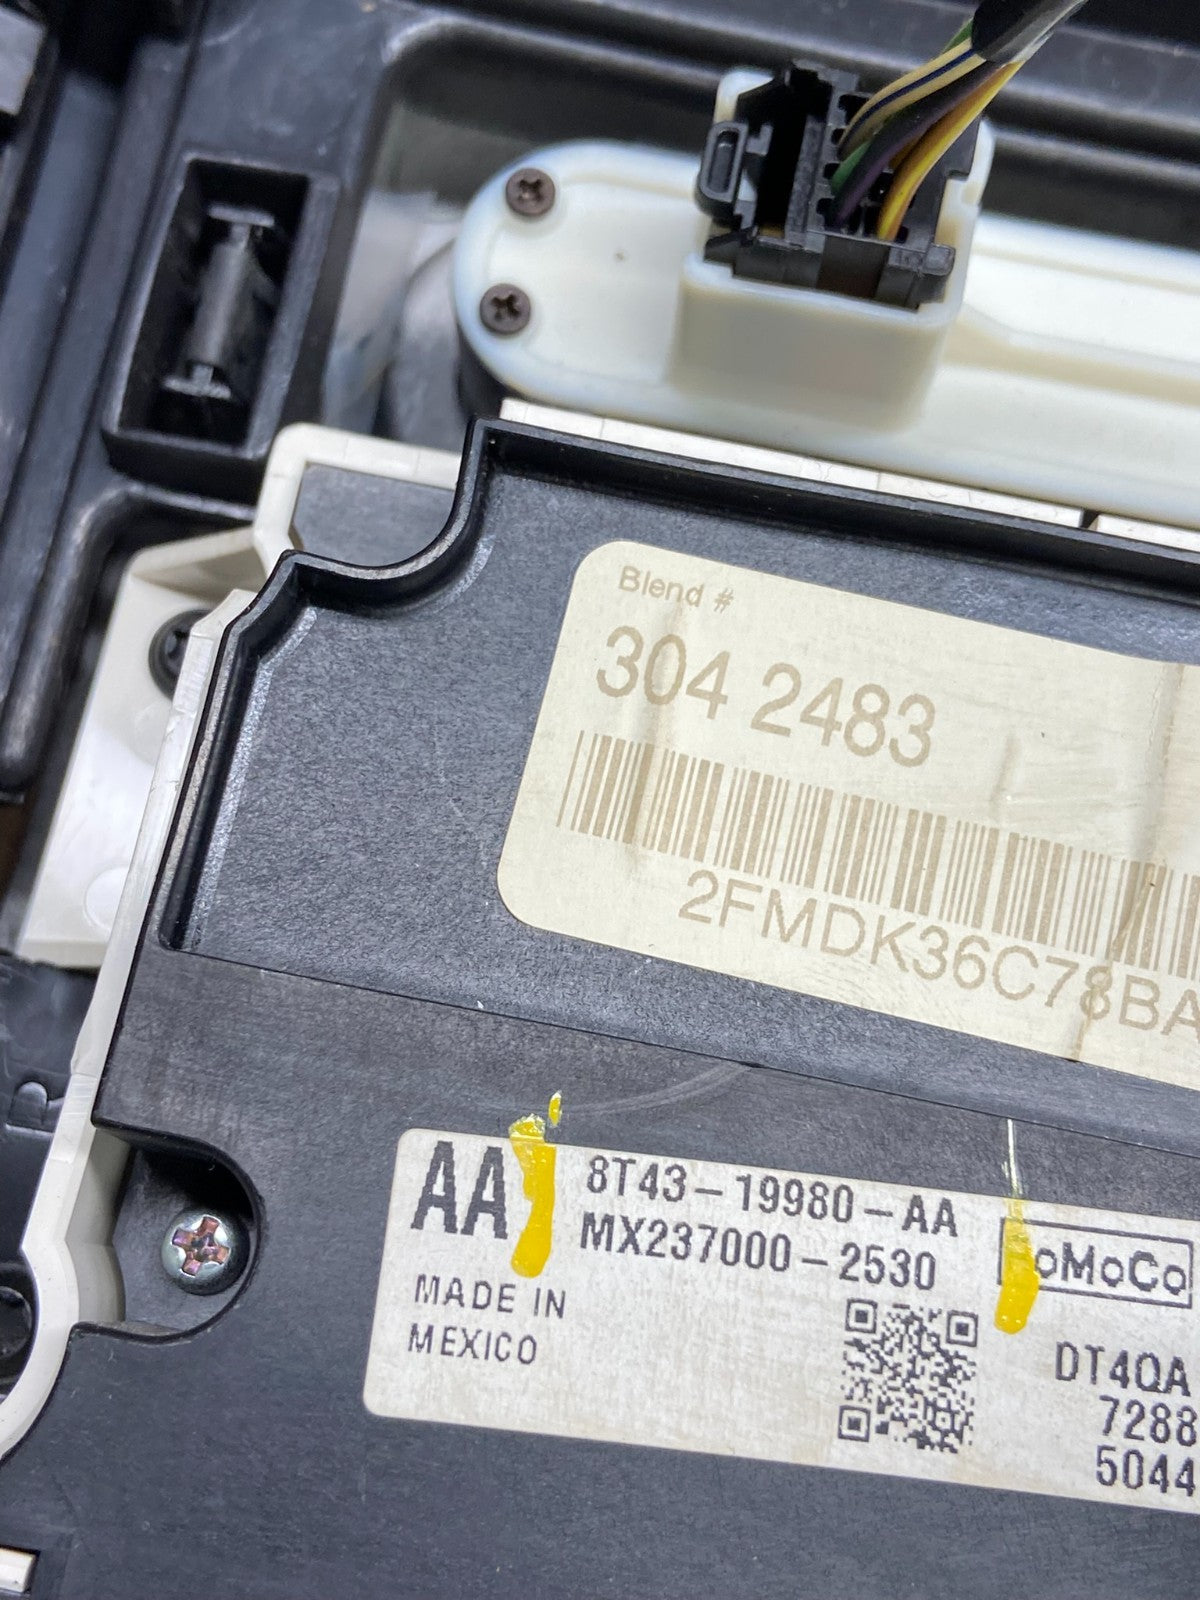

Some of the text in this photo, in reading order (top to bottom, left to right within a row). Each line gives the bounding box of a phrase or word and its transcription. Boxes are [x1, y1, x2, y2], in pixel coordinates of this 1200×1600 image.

[618, 565, 735, 613] Blend #
[596, 625, 937, 768] 304 2483
[411, 1140, 508, 1240] AA
[1008, 1240, 1188, 1296] oMoCo
[415, 1274, 567, 1319] MADE IN
[407, 1322, 538, 1366] MEXICO
[1099, 1394, 1198, 1447] 7288
[1096, 1445, 1196, 1497] 5044
